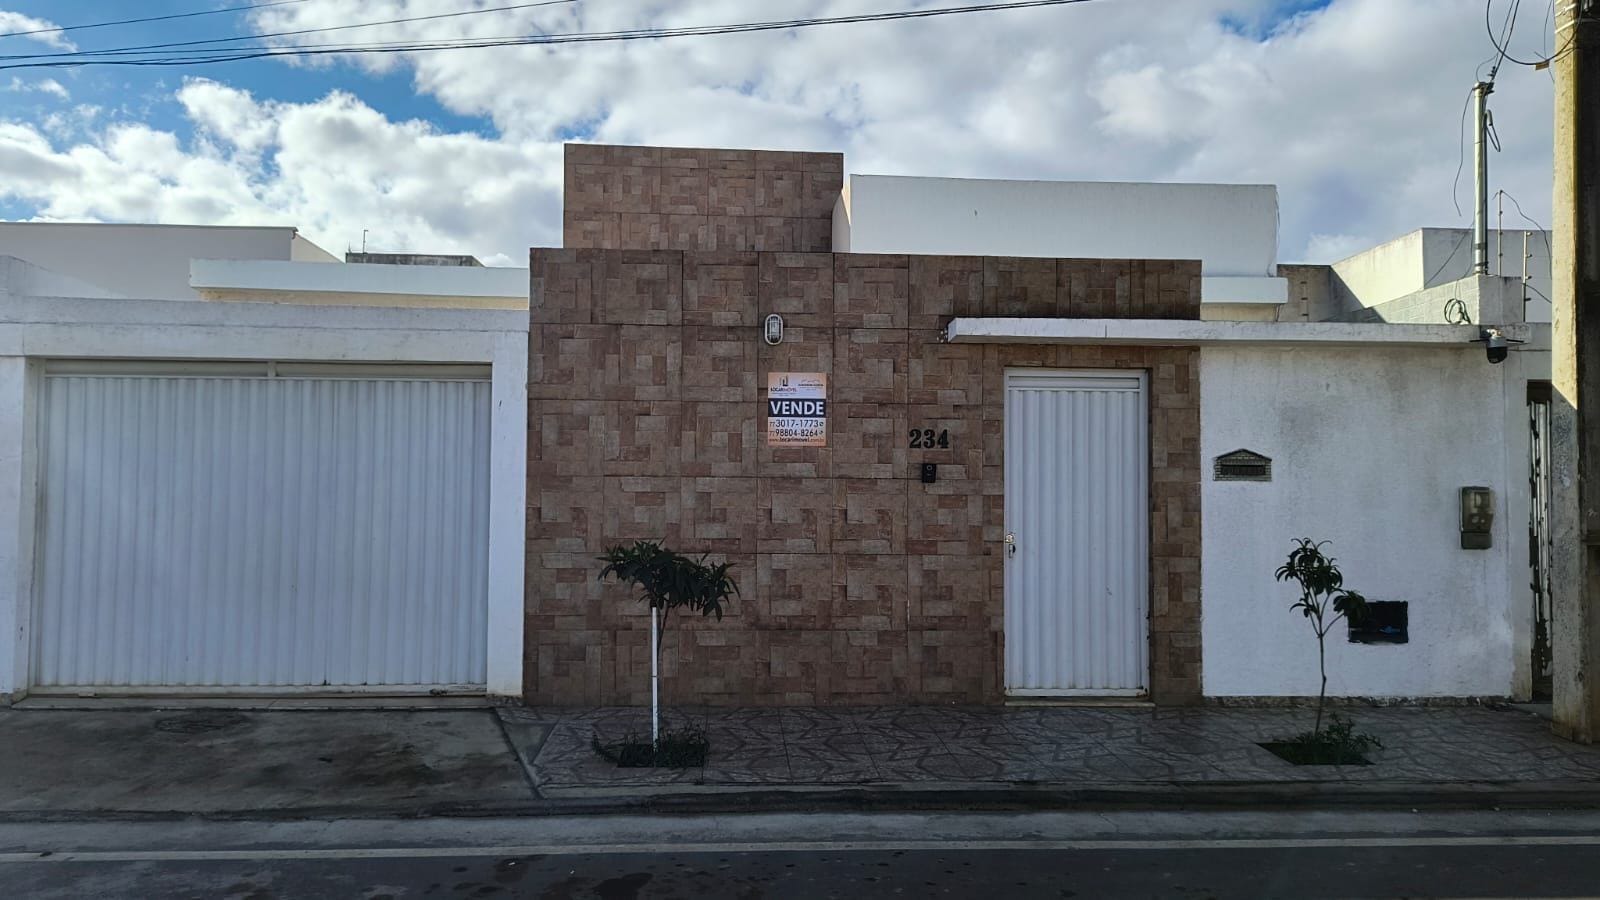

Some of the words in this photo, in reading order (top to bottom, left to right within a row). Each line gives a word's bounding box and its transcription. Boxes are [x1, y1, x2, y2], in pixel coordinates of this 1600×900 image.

[770, 400, 824, 415] VENDE
[775, 419, 819, 428] 3017-1773
[775, 428, 818, 437] 98804-8264
[909, 429, 949, 449] 234
